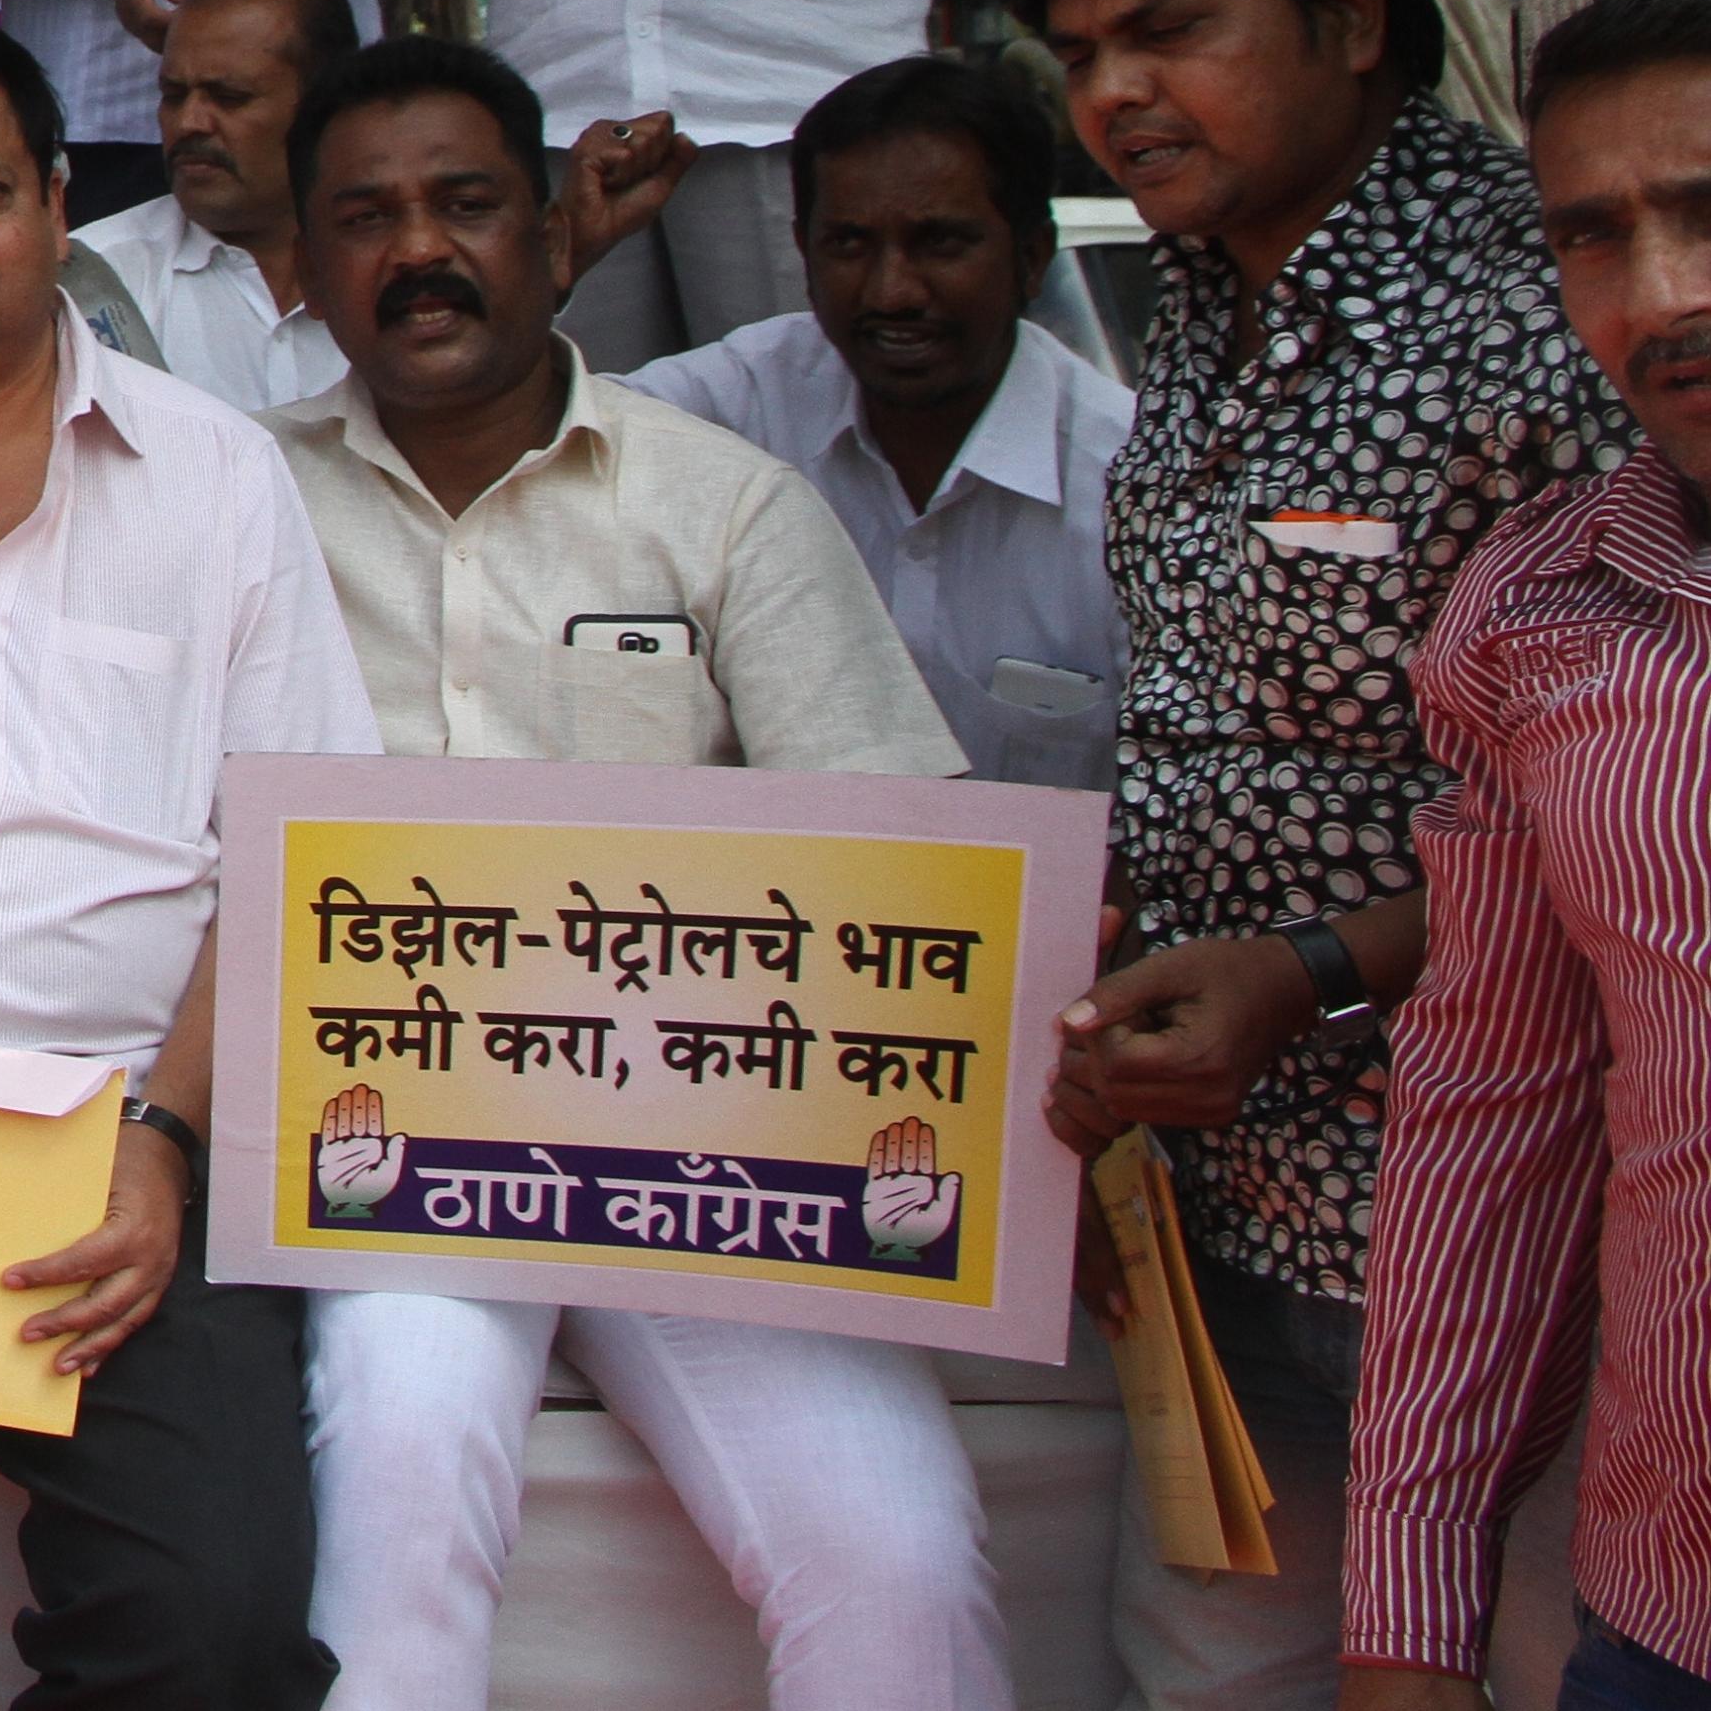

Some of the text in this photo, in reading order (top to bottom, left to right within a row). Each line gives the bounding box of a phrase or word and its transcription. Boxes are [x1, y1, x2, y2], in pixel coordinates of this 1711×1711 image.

[836, 921, 982, 995] भाव
[308, 984, 464, 1073] कमी
[655, 1001, 817, 1091] कमी
[831, 1029, 979, 1104] करा
[414, 1146, 583, 1238] ठाणे
